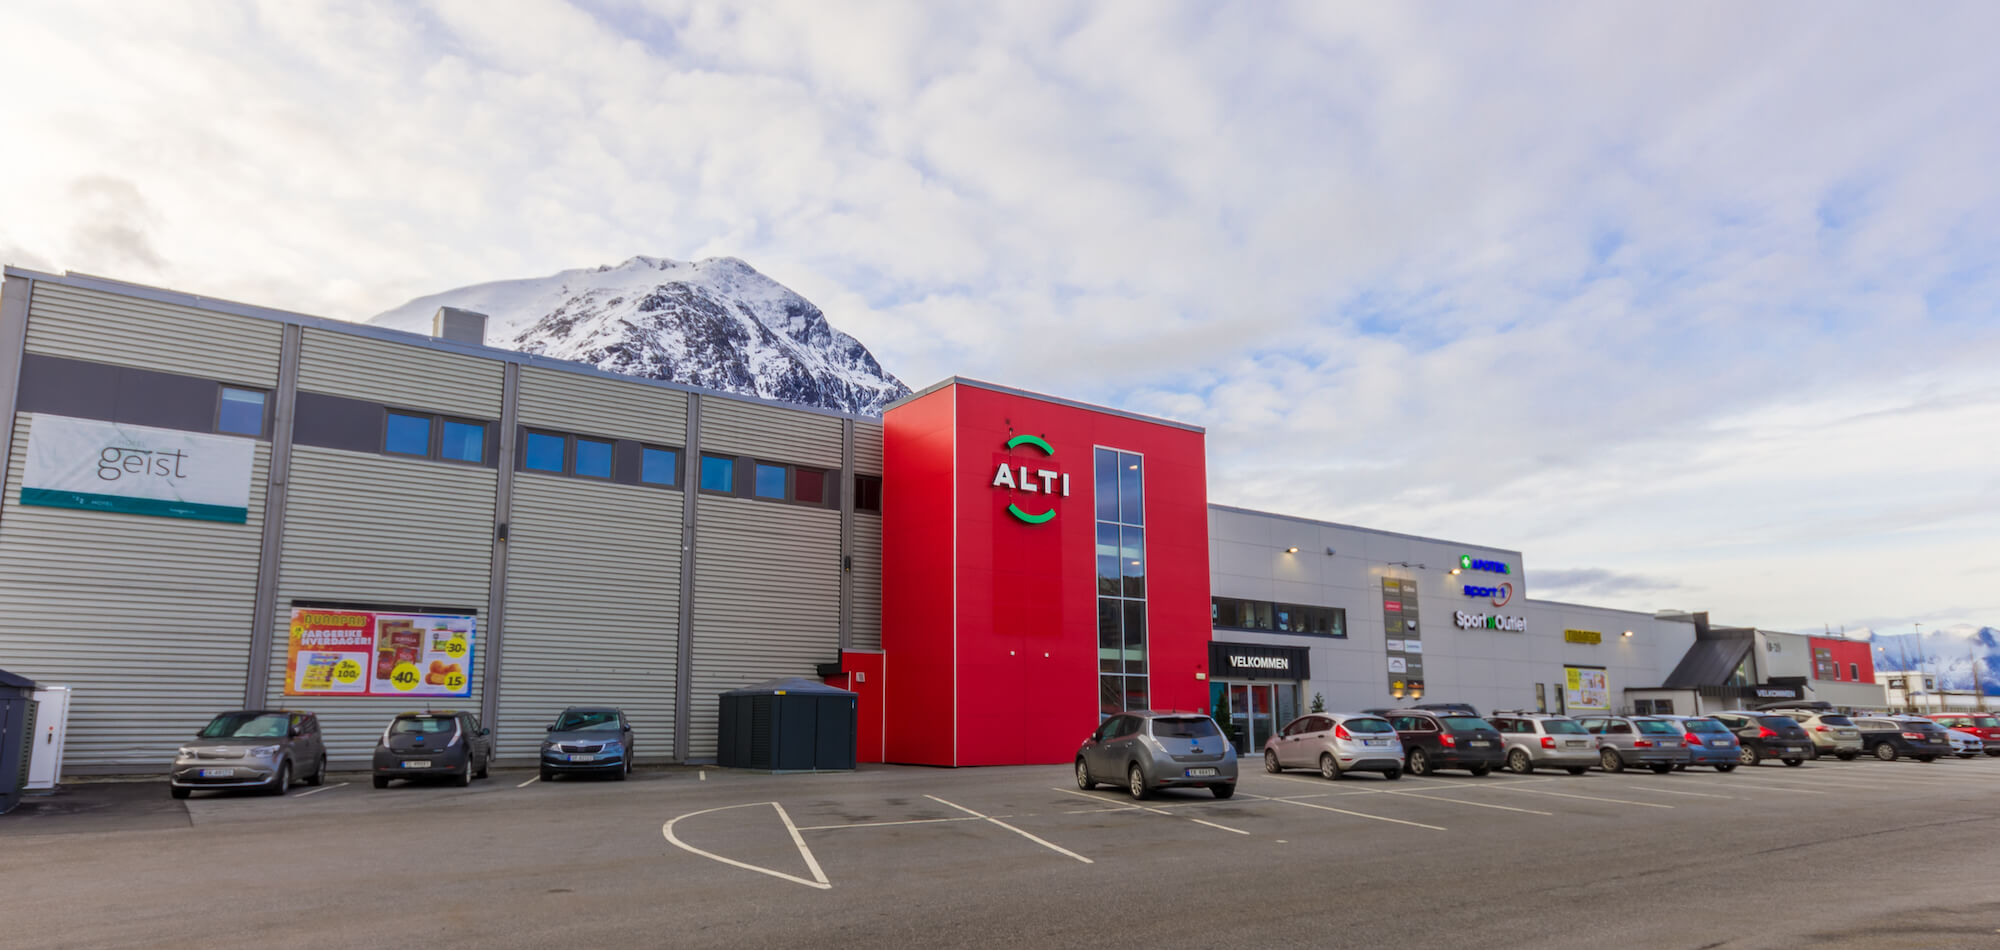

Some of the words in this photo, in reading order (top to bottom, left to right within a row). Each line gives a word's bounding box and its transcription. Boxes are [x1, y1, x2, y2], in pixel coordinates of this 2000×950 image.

[97, 446, 188, 480] geist
[993, 463, 1069, 496] ALTI
[1472, 559, 1505, 574] APOTEK
[1464, 585, 1497, 598] sport
[1230, 655, 1288, 670] VELKOMMEN
